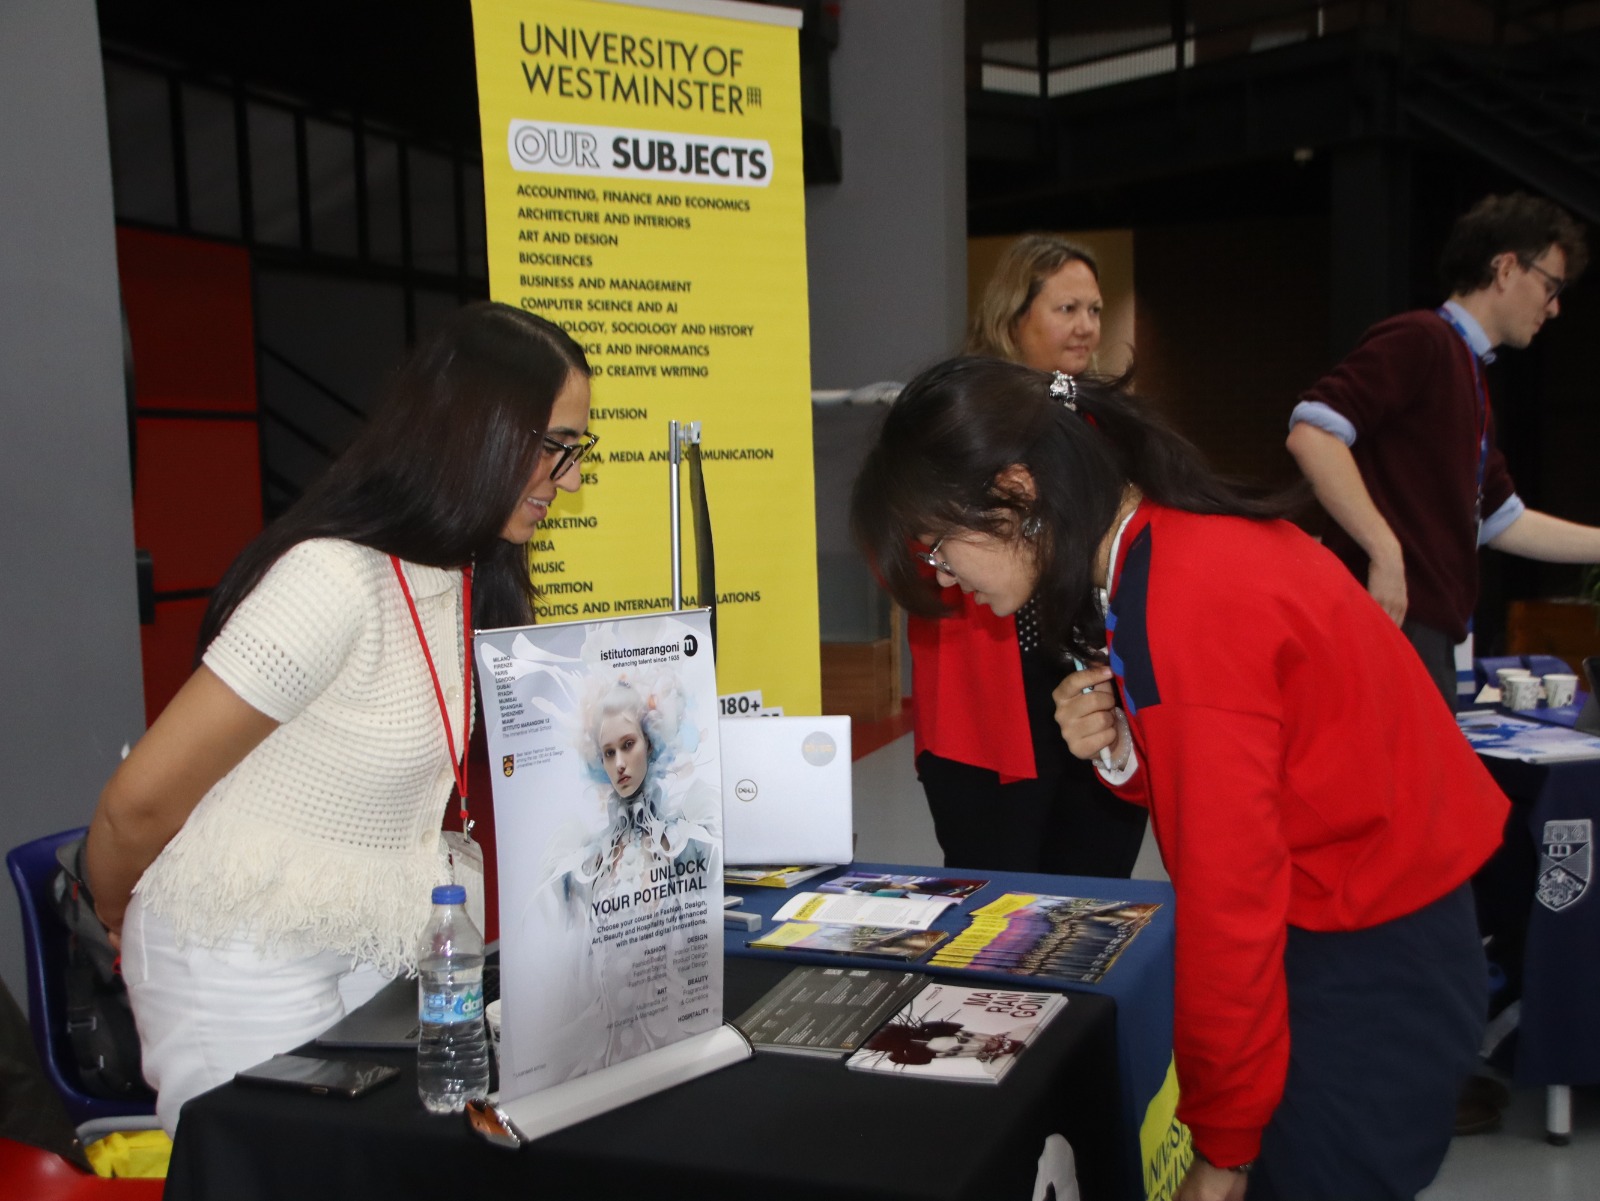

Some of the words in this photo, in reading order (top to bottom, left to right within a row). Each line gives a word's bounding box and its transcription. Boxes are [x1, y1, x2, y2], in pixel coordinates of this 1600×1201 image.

[520, 21, 698, 71] UNIVERSITY
[703, 46, 743, 77] OF
[521, 60, 744, 115] WESTMINSTER
[514, 125, 600, 168] OUR
[612, 136, 767, 180] SUBJECTS
[517, 184, 598, 204] ACCOUNTING,
[603, 190, 653, 205] FINANCE
[656, 193, 682, 207] AND
[685, 195, 750, 212] ECONOMICS
[518, 207, 600, 224] ARCHITECTURE
[604, 212, 630, 225] AND
[633, 214, 691, 229] INTERIORS
[518, 230, 539, 243] ART
[543, 231, 570, 244] AND
[574, 233, 618, 247] DESIGN
[519, 252, 593, 267] BIOSCIENCES
[520, 274, 574, 289] BUSINESS
[578, 277, 605, 290] AND
[609, 279, 692, 293] MANAGEMENT
[521, 297, 583, 312] COMPUTER
[587, 299, 633, 312] SCIENCE
[637, 300, 662, 313] AND
[666, 301, 678, 313] AI
[611, 321, 677, 335] SOCIOLOGY
[681, 323, 706, 336] AND
[709, 324, 754, 337] HISTORY
[606, 343, 632, 355] AND
[636, 344, 709, 357] INFORMATICS
[607, 365, 657, 378] CREATIVE
[661, 366, 709, 378] WRITING
[590, 408, 647, 420] ELEVISION
[609, 450, 645, 462] MEDIA
[649, 450, 670, 462] AN
[530, 540, 555, 552] MBA
[531, 561, 565, 574] MUSIC
[583, 601, 610, 614] AND
[716, 591, 761, 604] LATIONS
[600, 642, 679, 661] istitutomarangoni
[613, 659, 637, 668] enhancing
[495, 676, 516, 684] LONDON
[500, 703, 523, 711] SHANGHAI
[720, 696, 760, 715] 180+
[521, 719, 544, 728] MARANGONI
[650, 858, 707, 883] UNLOCK
[592, 894, 630, 916] YOUR
[634, 877, 707, 906] POTENTIAL
[597, 923, 619, 933] Choose
[620, 919, 633, 928] your
[634, 914, 652, 922] course
[660, 904, 683, 916] Fashion,
[684, 900, 707, 910] Design,
[604, 931, 624, 942] Beauty
[625, 927, 635, 935] and
[637, 919, 664, 933] Hospitality
[678, 909, 707, 920] enhanced
[616, 938, 628, 948] with
[629, 936, 637, 944] the
[639, 931, 654, 942] latest
[655, 926, 671, 937] digital
[687, 934, 708, 943] DESIGN
[644, 944, 666, 956] FASHION
[688, 975, 708, 985] BEAUTY
[963, 991, 997, 1006] MA
[985, 992, 1024, 1013] RAN
[1010, 994, 1052, 1018] GONI
[678, 1008, 709, 1023] HOSPITALITY
